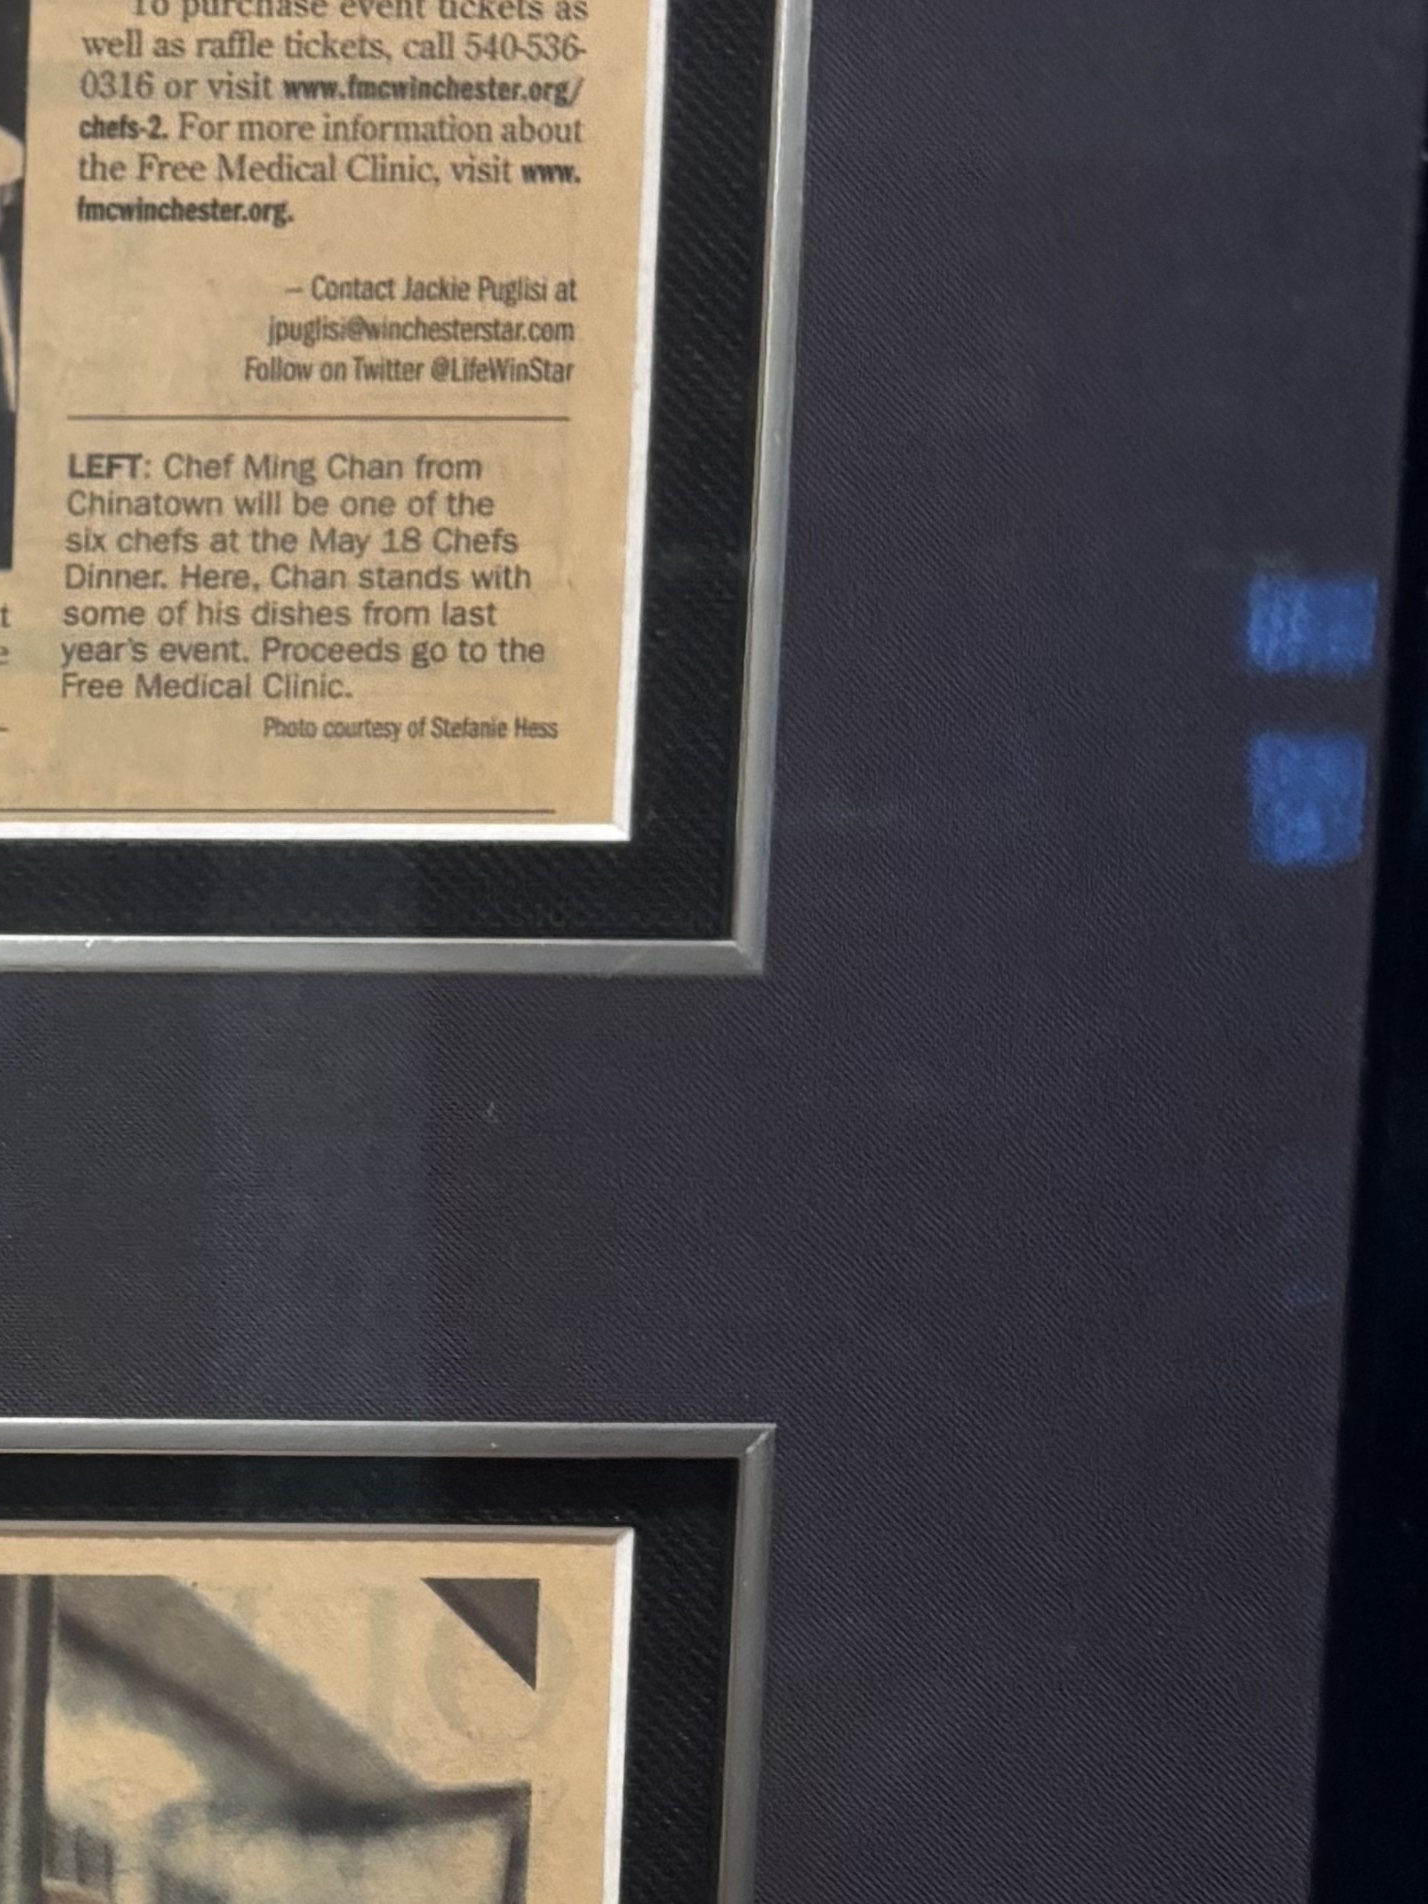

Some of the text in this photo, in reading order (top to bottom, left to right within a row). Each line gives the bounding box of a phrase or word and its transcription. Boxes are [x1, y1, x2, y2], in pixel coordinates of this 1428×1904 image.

[79, 68, 156, 101] 0316
[163, 77, 200, 101] or
[206, 68, 274, 102] visit
[244, 354, 576, 385] Follow on Twitter @LifeWinStar
[67, 451, 484, 486] LEFT: Chef Ming Chan from
[60, 666, 354, 701] Free Medical Clinic.
[263, 715, 560, 743] Photo courtesy of Stefanie Hess
